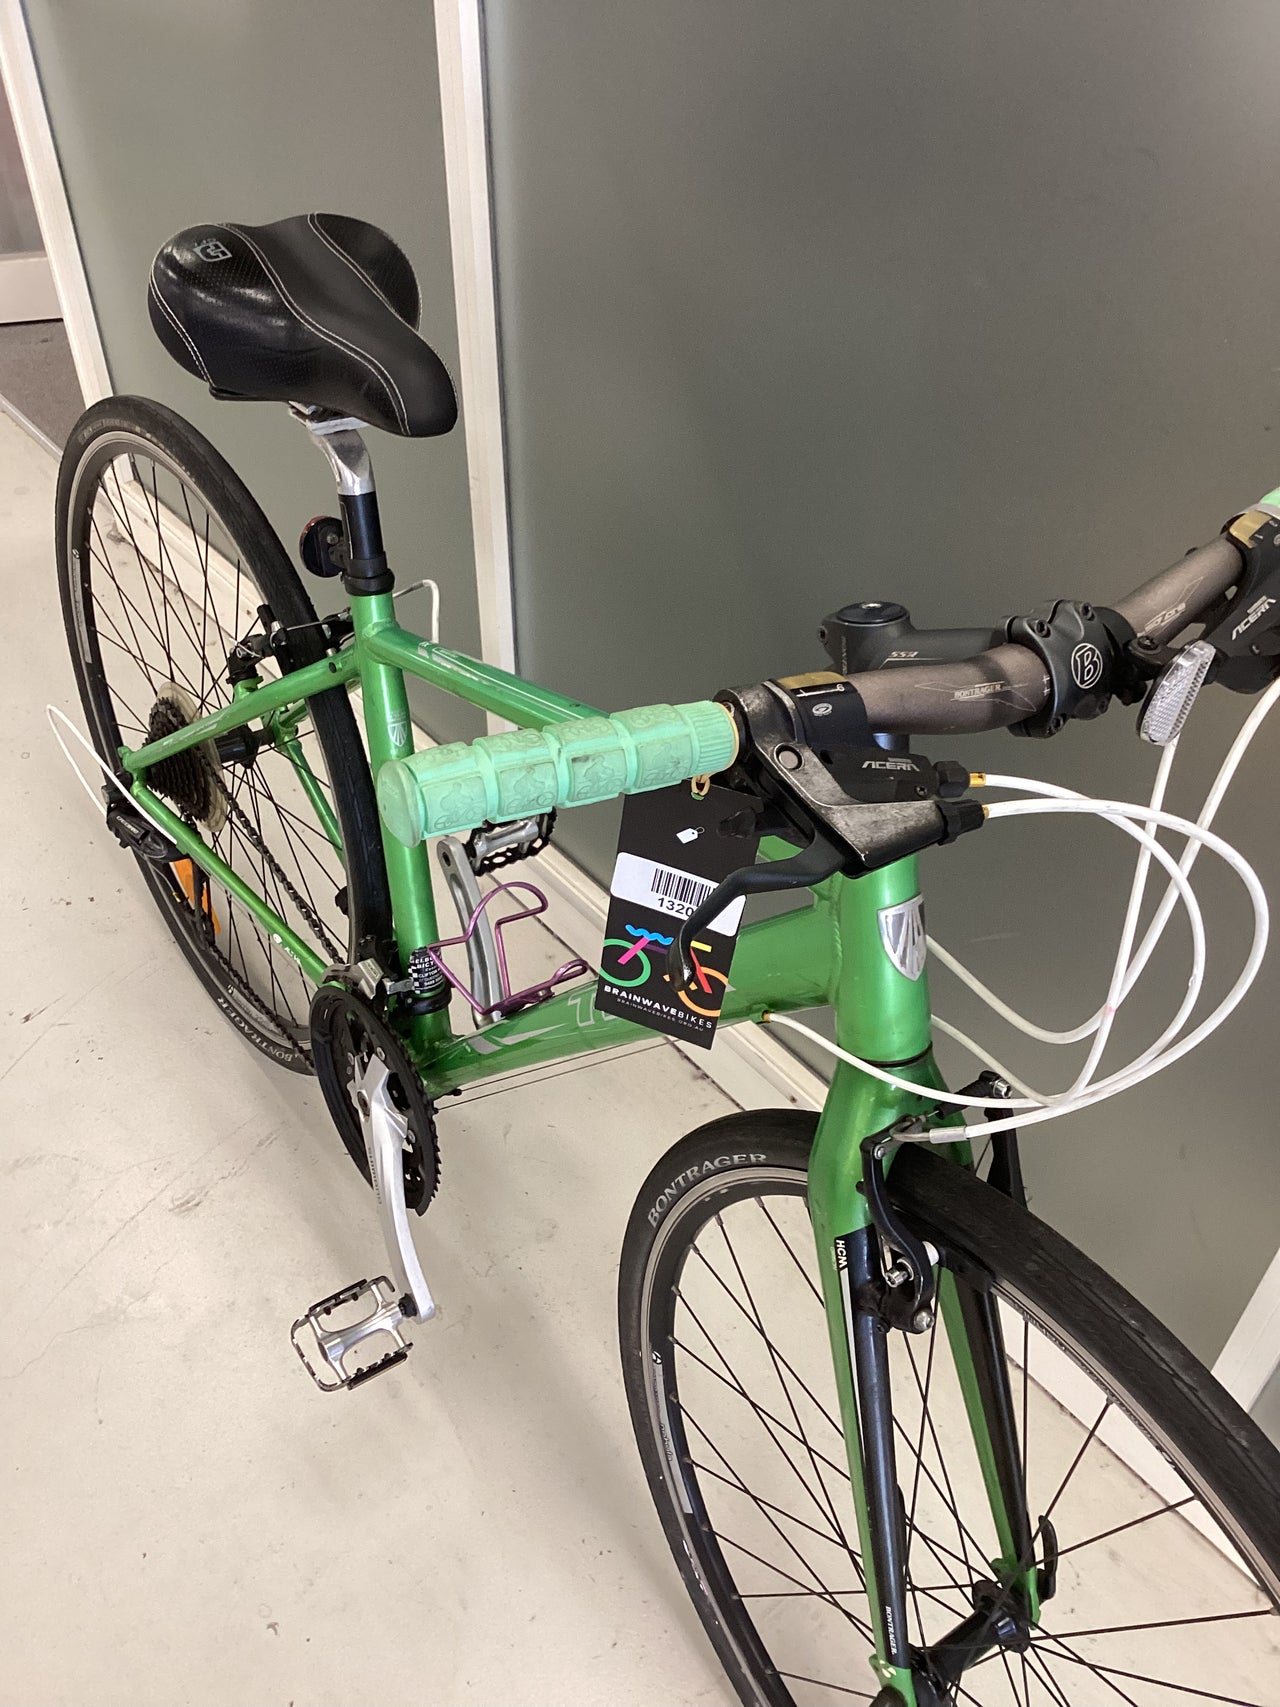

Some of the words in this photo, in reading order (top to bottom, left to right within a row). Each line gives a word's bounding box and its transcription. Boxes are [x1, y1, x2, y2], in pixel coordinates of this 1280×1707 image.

[954, 684, 1002, 699] BONTRAGER
[658, 897, 695, 917] 1320
[604, 985, 713, 1029] BRAINWAVEBIKES
[217, 998, 293, 1062] BONTRAGER
[647, 1153, 767, 1228] BONTRAGER
[835, 1239, 848, 1268] HCM
[885, 1605, 898, 1655] BONTRAGER
